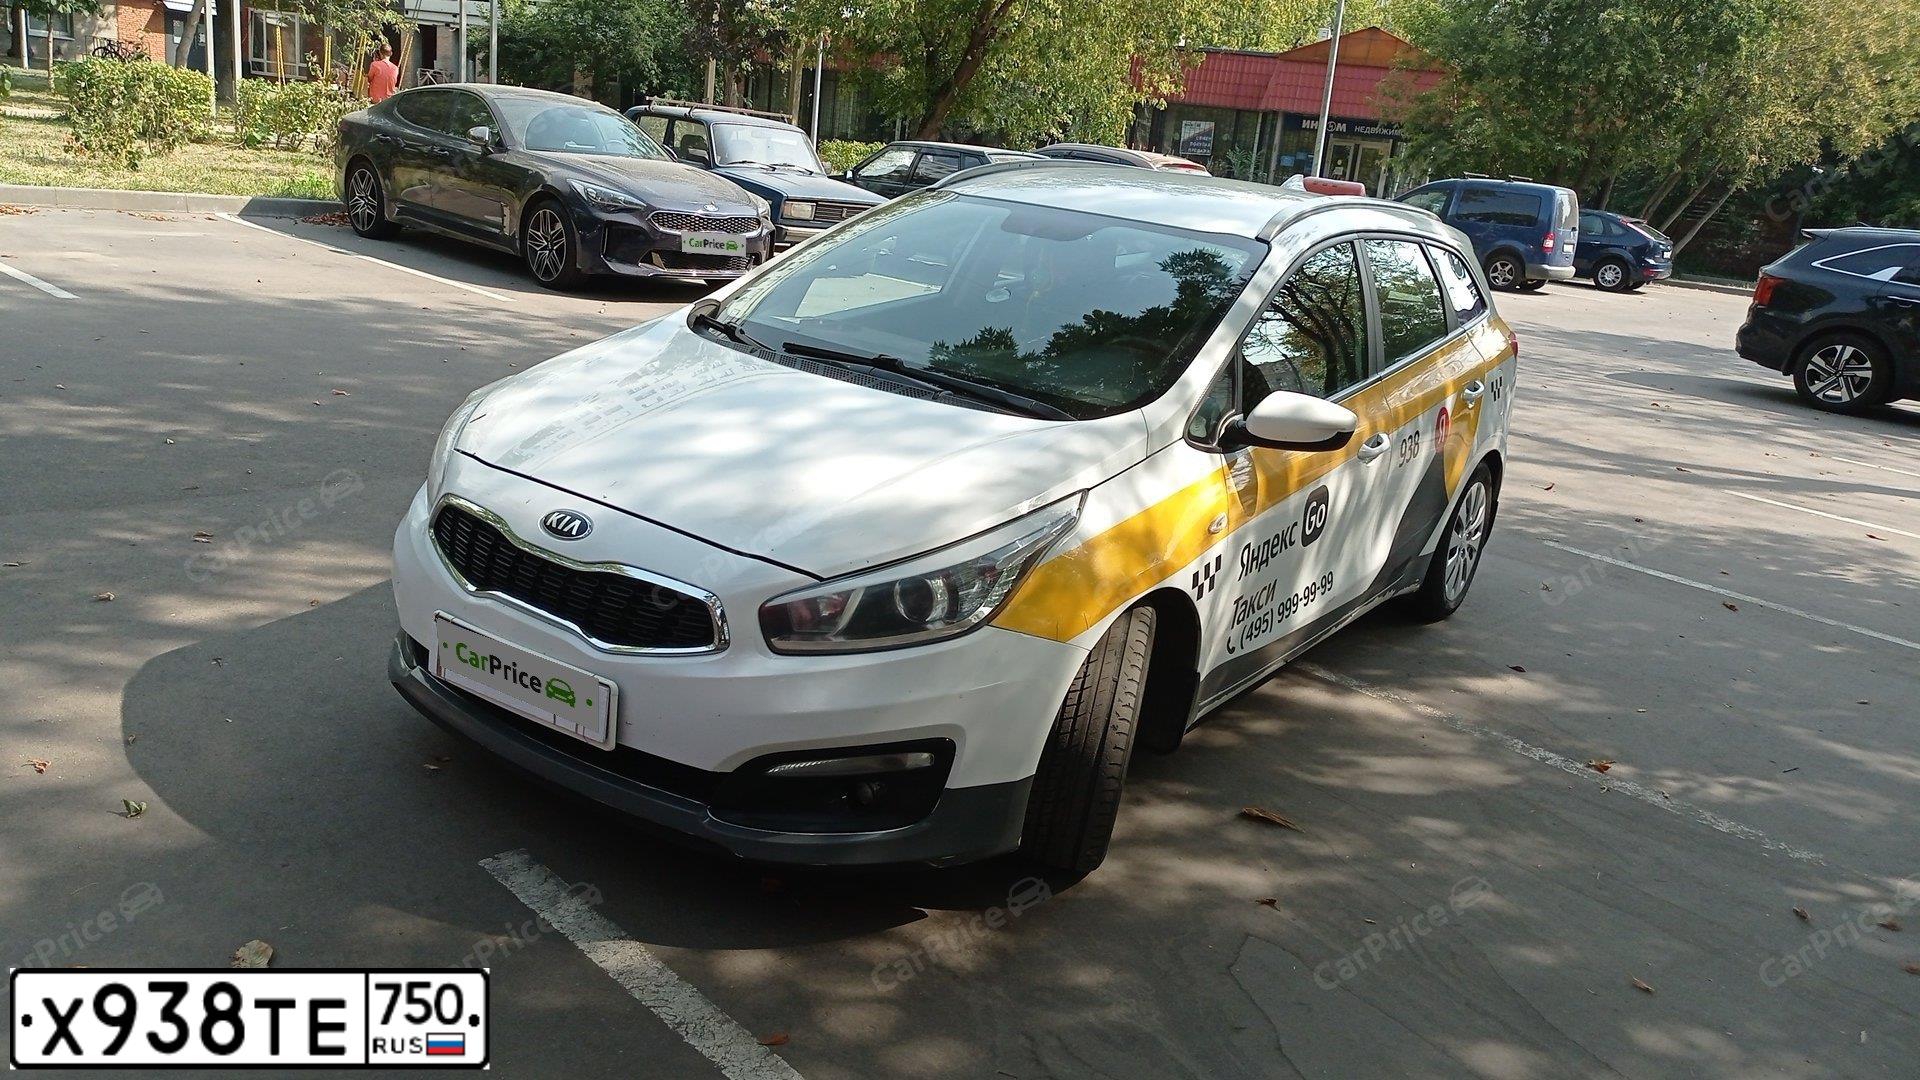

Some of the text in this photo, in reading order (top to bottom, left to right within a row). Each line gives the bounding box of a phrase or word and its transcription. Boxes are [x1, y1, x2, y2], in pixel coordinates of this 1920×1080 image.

[1301, 119, 1401, 136] ИНОМ НЕДВИЖИМ
[1398, 431, 1421, 468] 938
[545, 512, 580, 535] KIA
[1238, 502, 1327, 582] Яндекс Go
[1230, 579, 1278, 630] Такси
[1240, 571, 1334, 649] (495) 999-99-99
